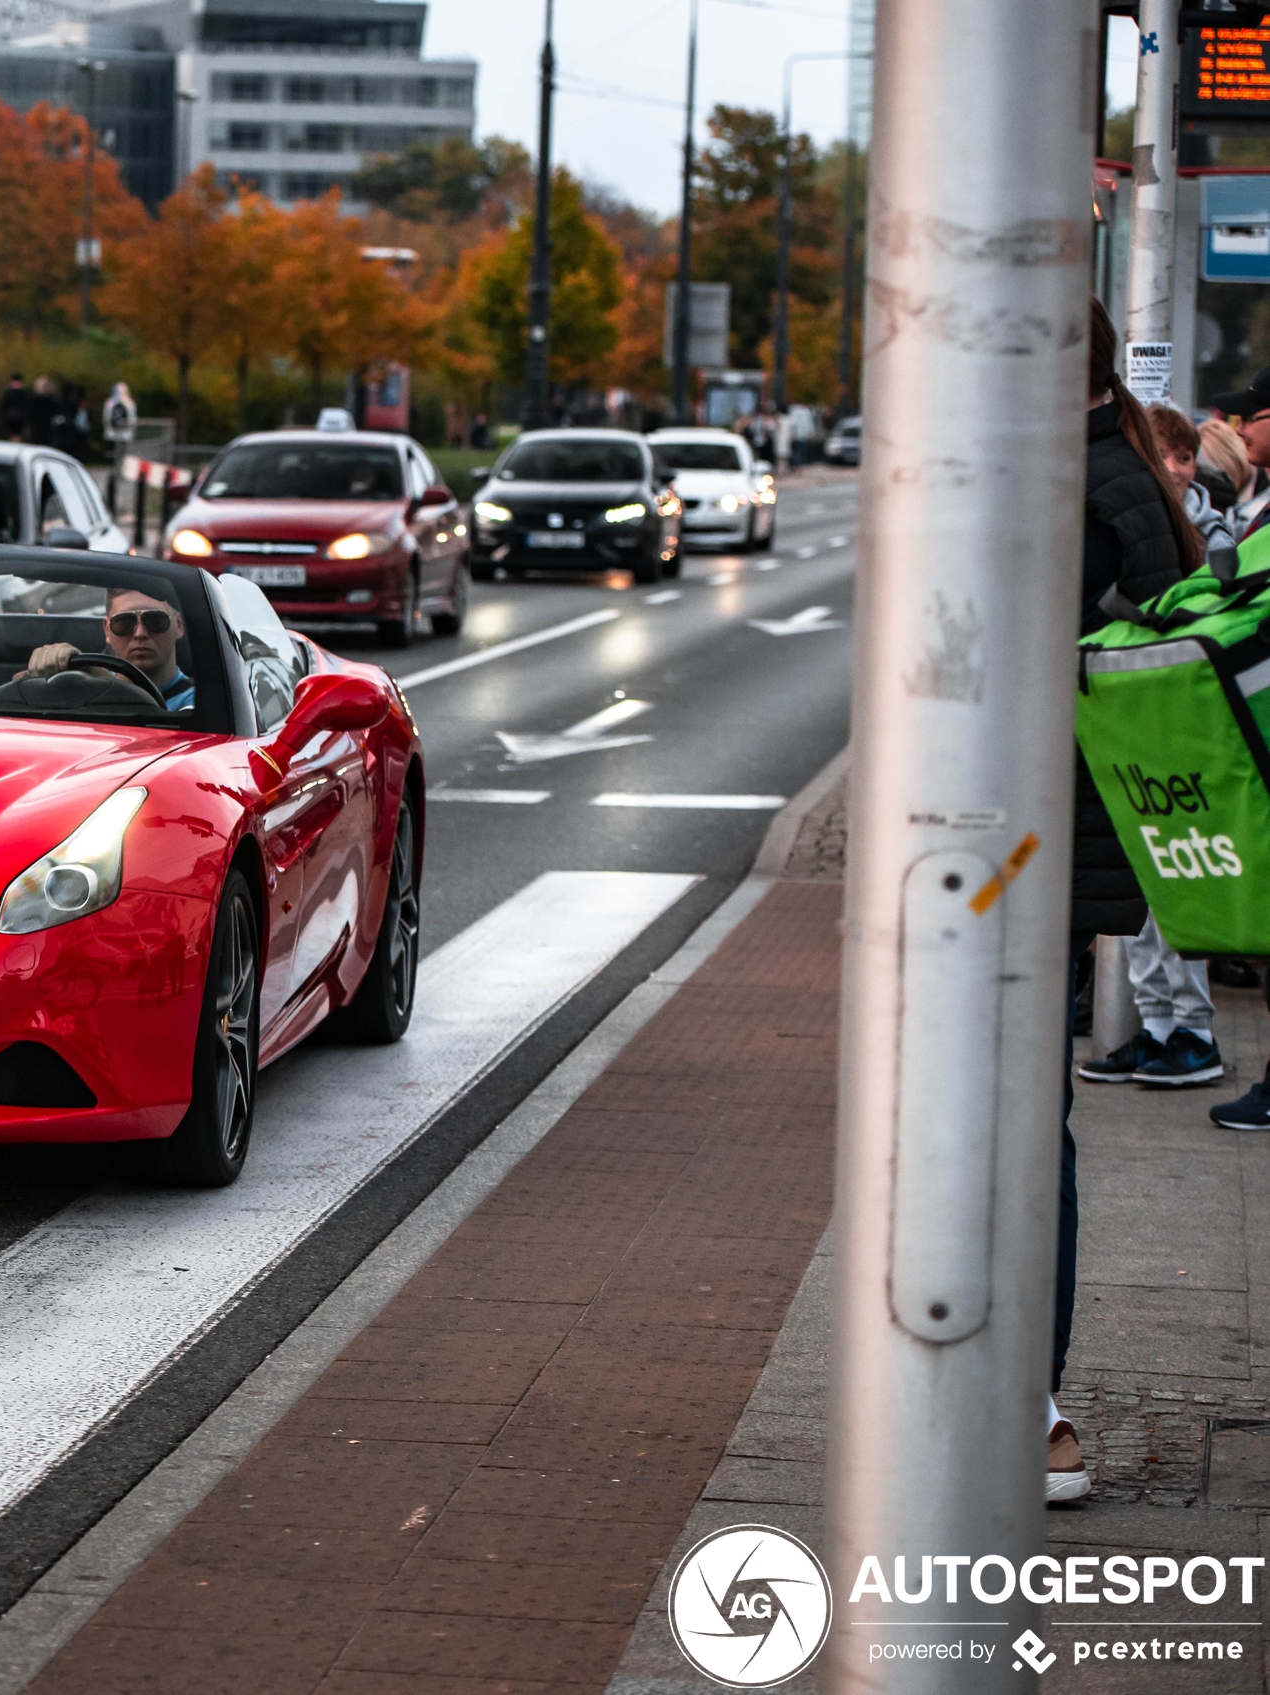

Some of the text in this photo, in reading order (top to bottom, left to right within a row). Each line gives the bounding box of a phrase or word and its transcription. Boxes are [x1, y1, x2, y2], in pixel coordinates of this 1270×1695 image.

[1132, 346, 1166, 357] UWAGA
[1113, 763, 1210, 816] Uber
[1140, 825, 1243, 879] Eats
